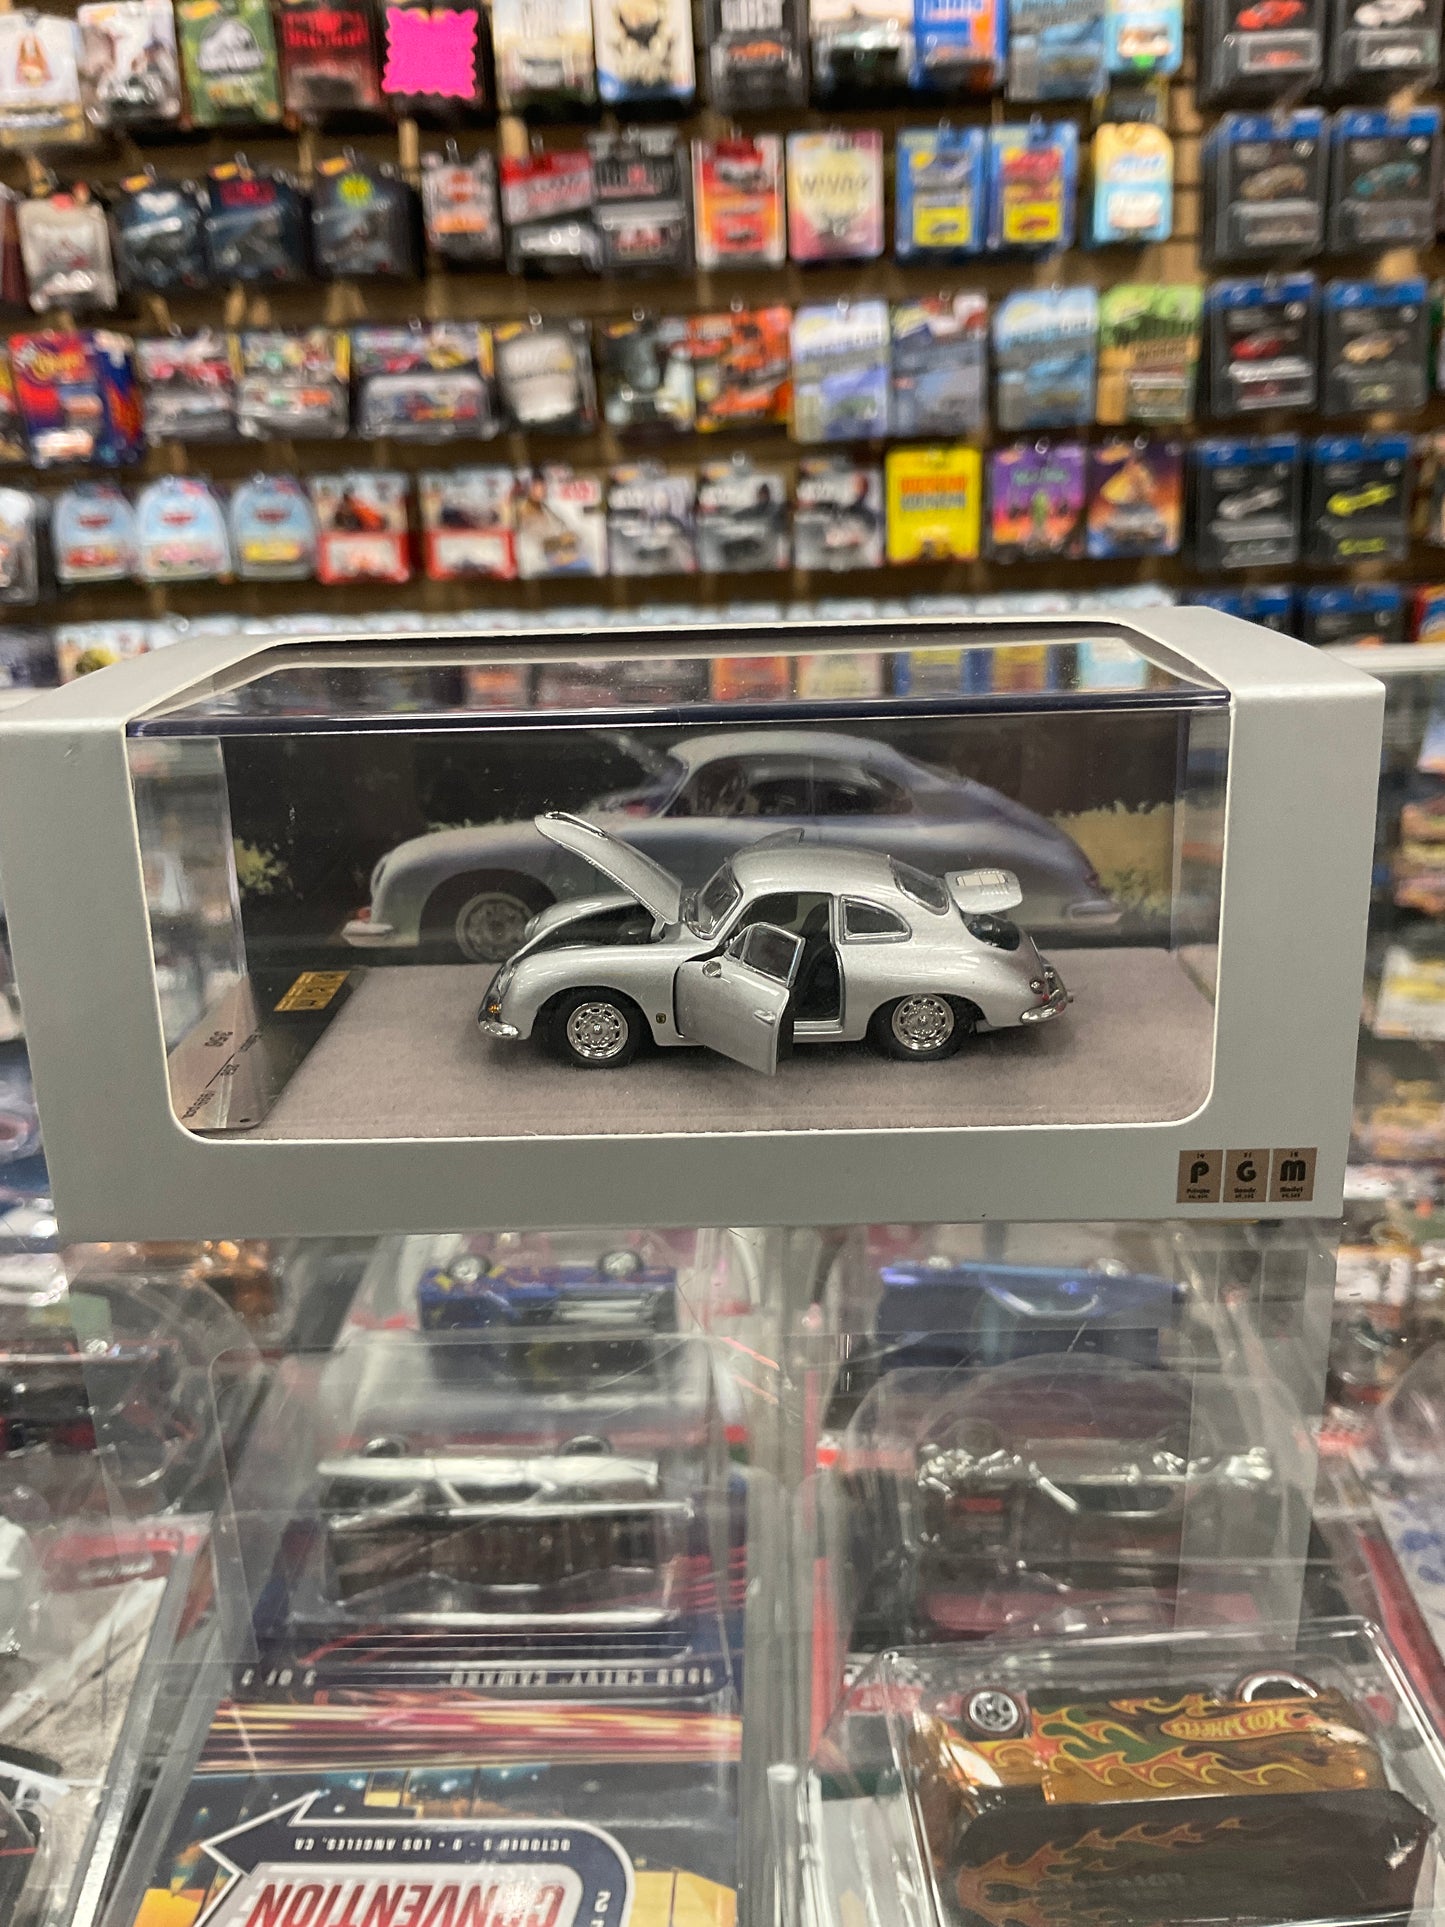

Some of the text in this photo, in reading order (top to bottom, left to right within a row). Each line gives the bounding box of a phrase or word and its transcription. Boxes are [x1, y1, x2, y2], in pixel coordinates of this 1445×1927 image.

[1190, 1161, 1210, 1184] P
[1236, 1160, 1257, 1182] G
[295, 1838, 315, 1851] CA
[402, 1838, 432, 1851] LOS
